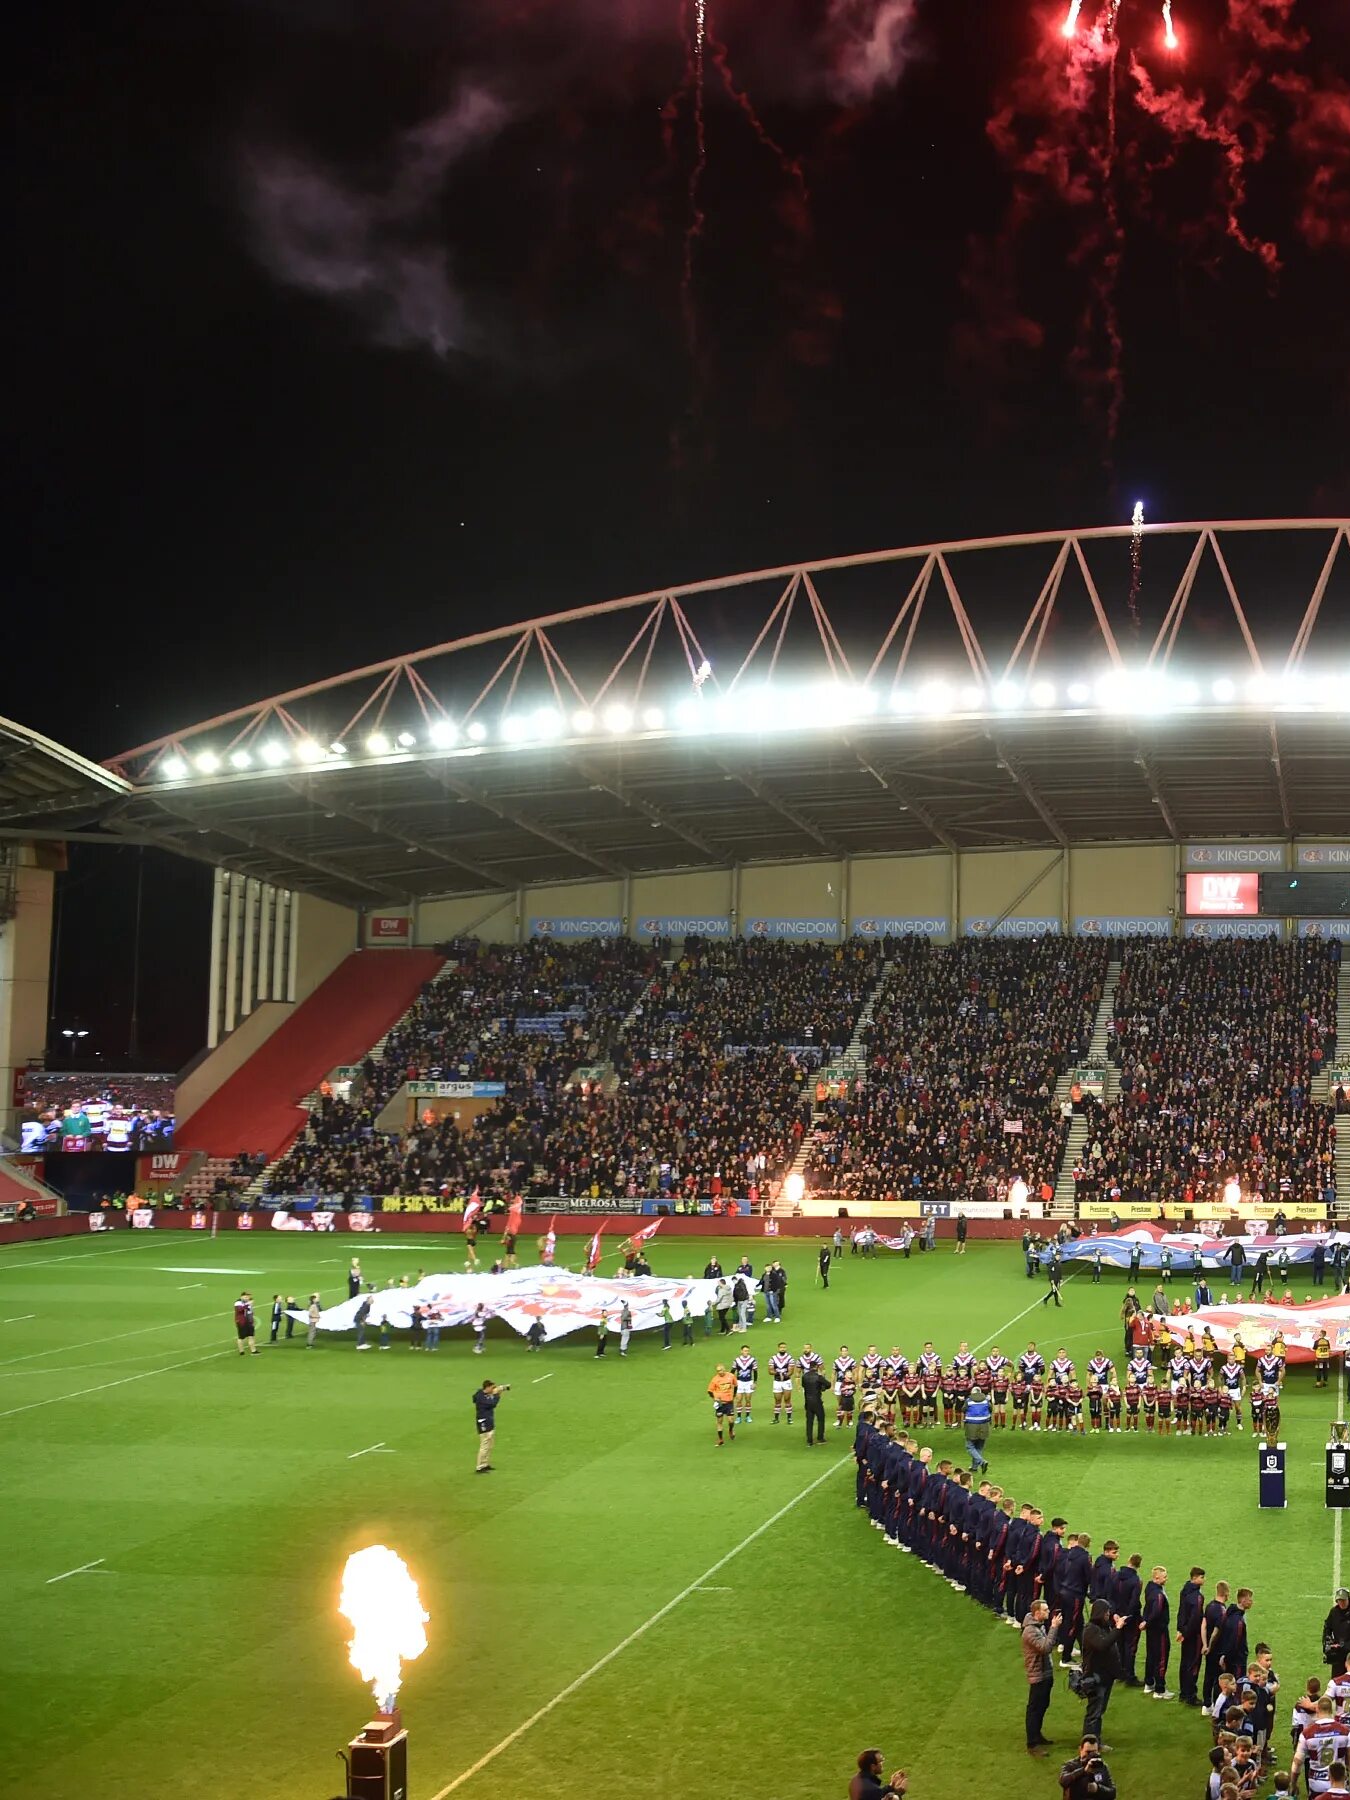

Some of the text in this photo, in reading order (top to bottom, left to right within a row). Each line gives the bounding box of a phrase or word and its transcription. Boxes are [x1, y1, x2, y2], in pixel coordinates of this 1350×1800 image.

[1217, 850, 1281, 862] KINGDOM
[1203, 877, 1240, 897] DW
[560, 921, 621, 933] KINGDOM
[667, 921, 729, 933] KINGDOM
[775, 921, 837, 933] KINGDOM
[884, 921, 946, 933] KINGDOM
[996, 921, 1058, 933] KINGDOM
[1106, 921, 1169, 933] KINGDOM
[1215, 924, 1280, 936] KINGDOM
[439, 1082, 471, 1091] argus
[152, 1154, 179, 1168] DW
[570, 1199, 617, 1207] MELROSA
[924, 1205, 947, 1214] FIT
